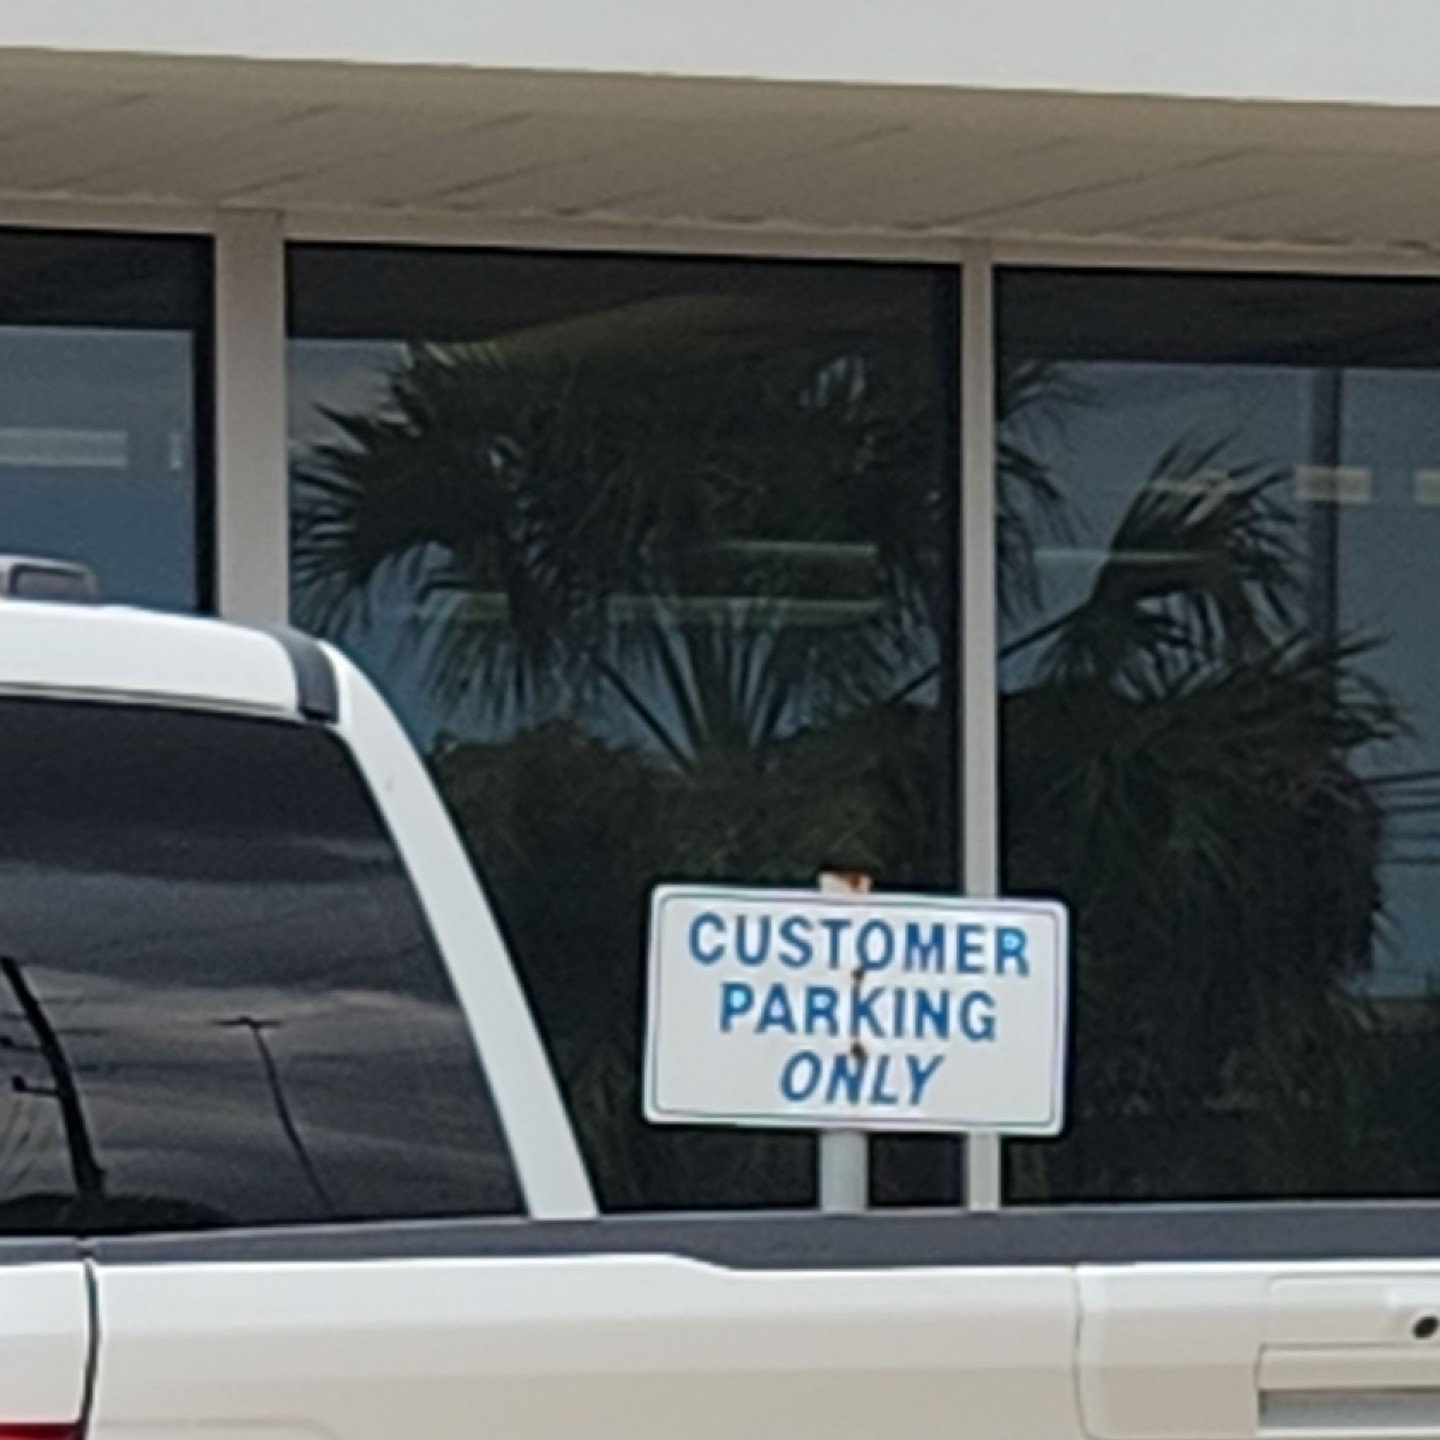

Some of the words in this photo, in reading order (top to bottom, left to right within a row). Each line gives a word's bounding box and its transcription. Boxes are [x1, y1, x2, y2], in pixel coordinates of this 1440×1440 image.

[688, 911, 1030, 977] CUSTOMER
[719, 981, 996, 1042] PARKING
[780, 1049, 945, 1106] ONLY
